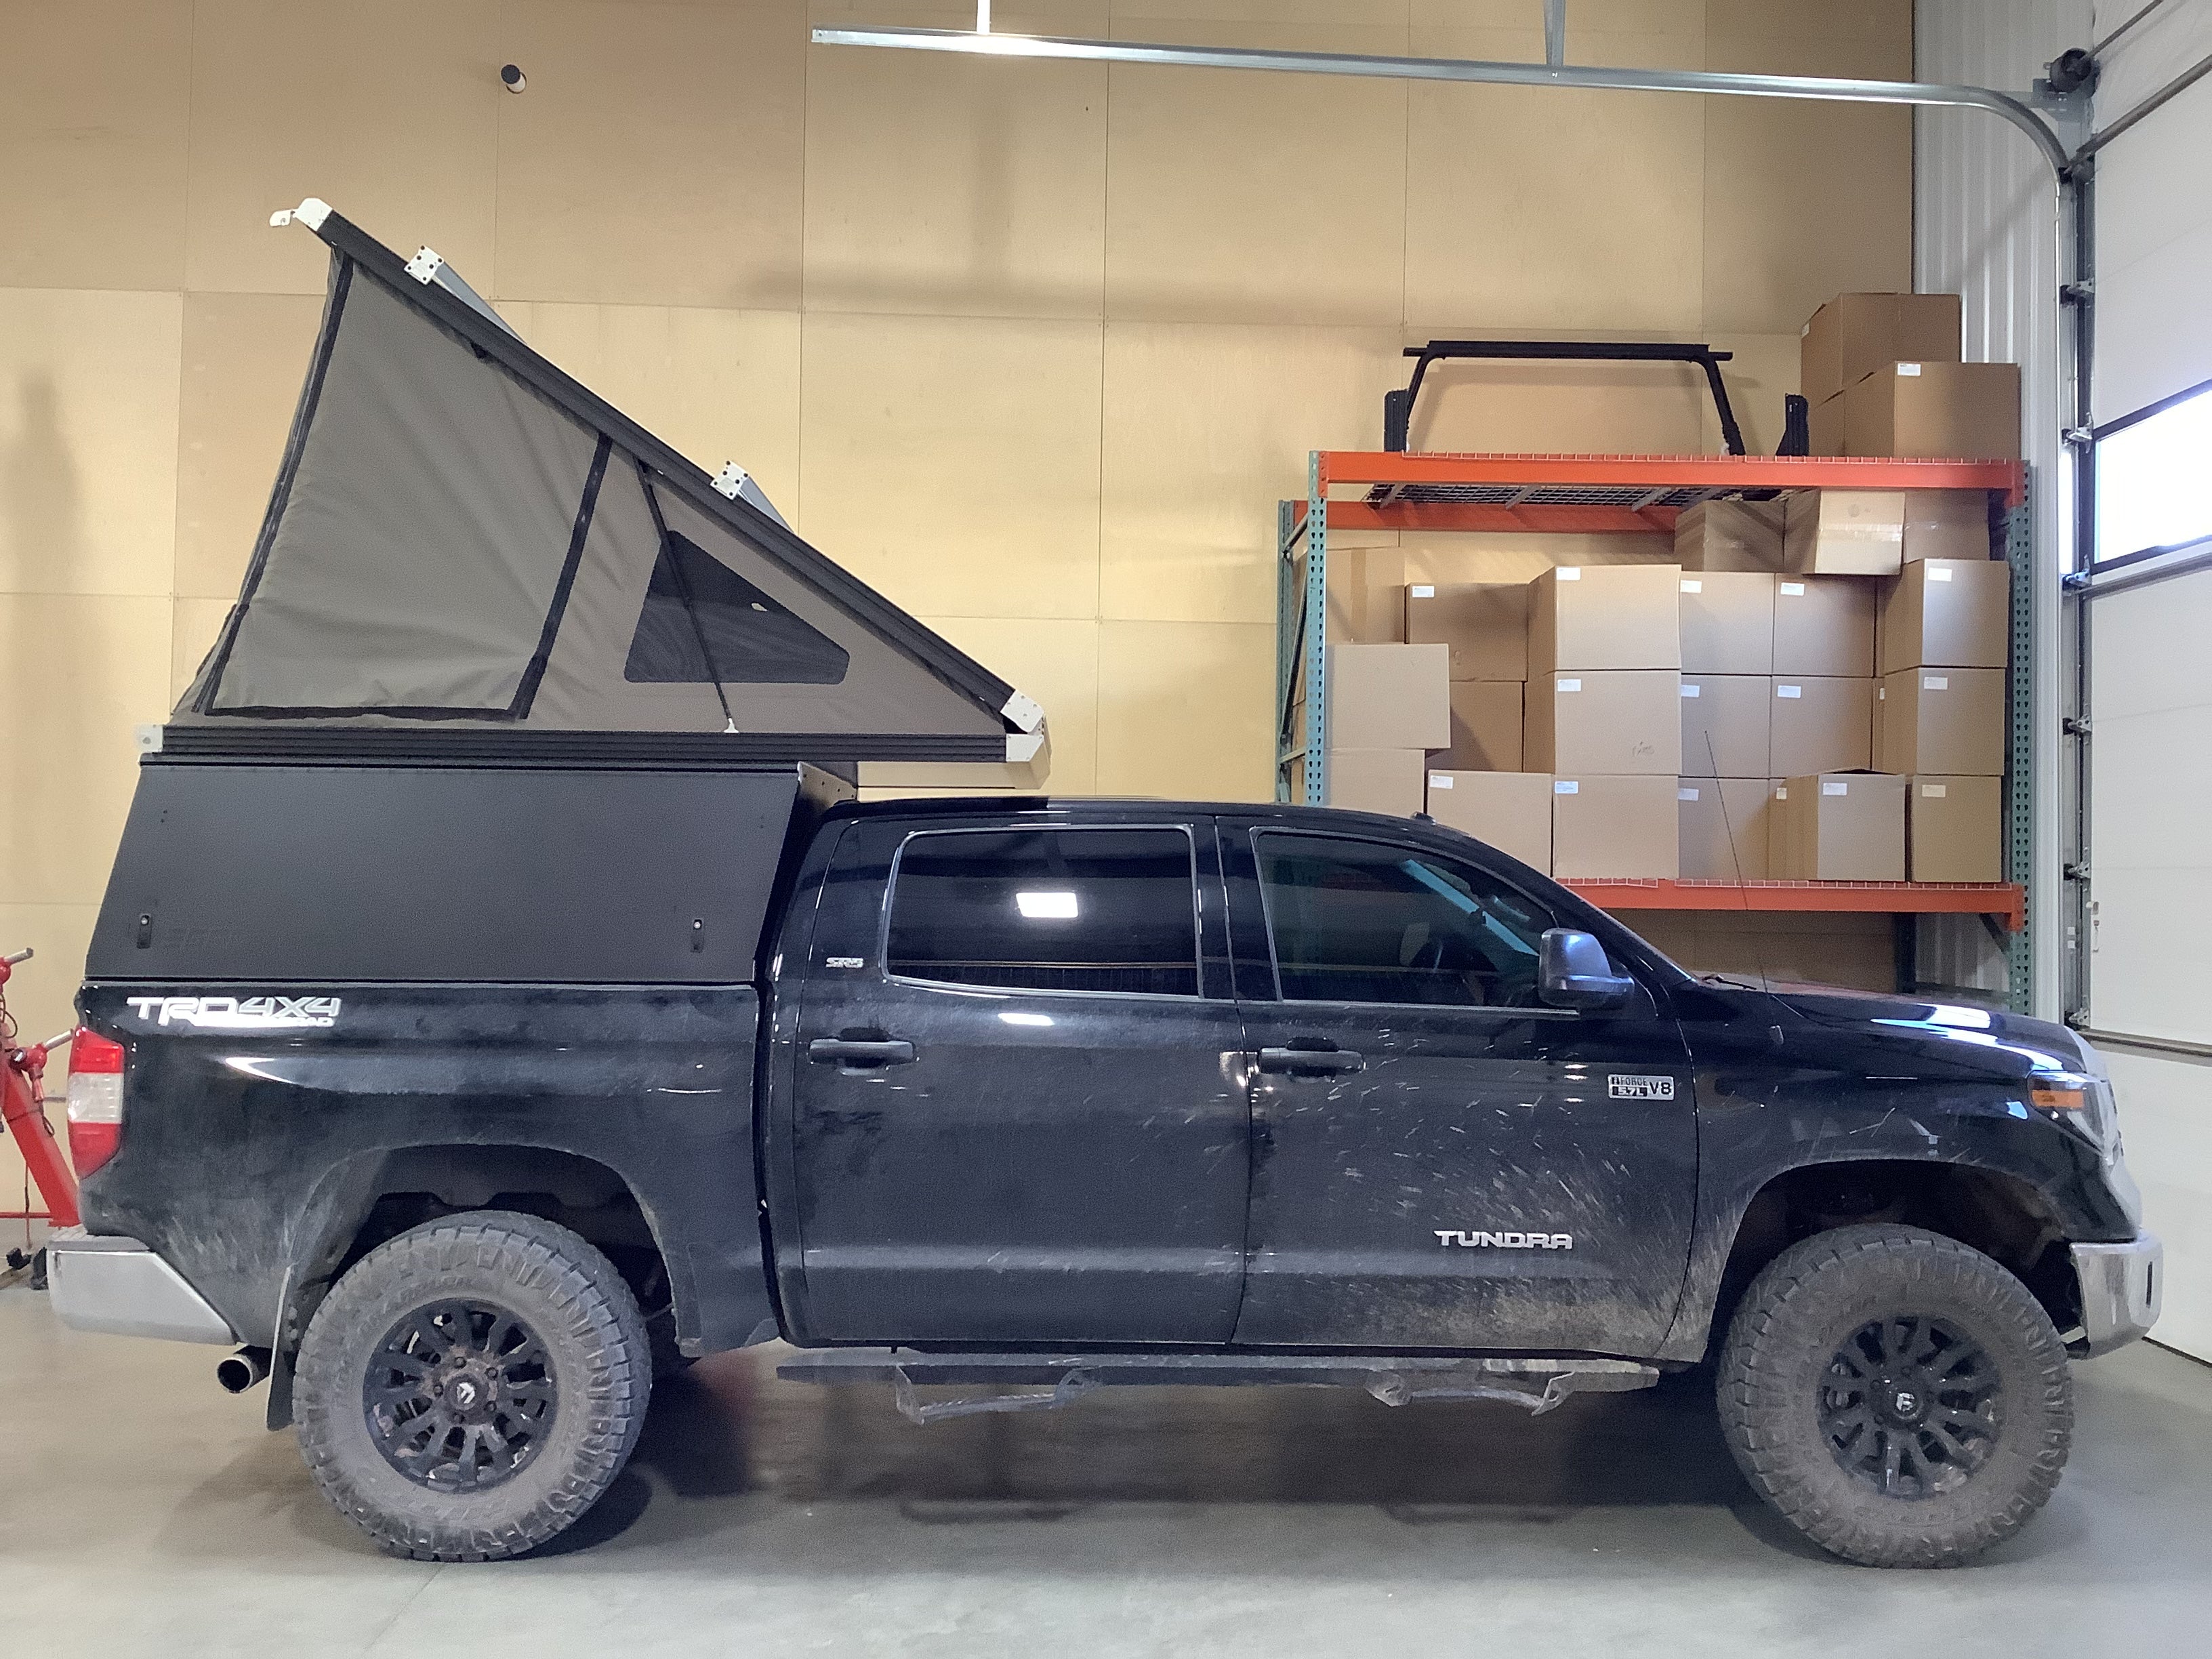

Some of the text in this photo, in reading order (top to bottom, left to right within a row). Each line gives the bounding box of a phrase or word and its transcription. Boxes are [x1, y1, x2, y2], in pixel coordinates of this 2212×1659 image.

[126, 996, 238, 1027] TRD
[1649, 1081, 1671, 1095] V8
[1433, 1230, 1573, 1250] TUNDRA
